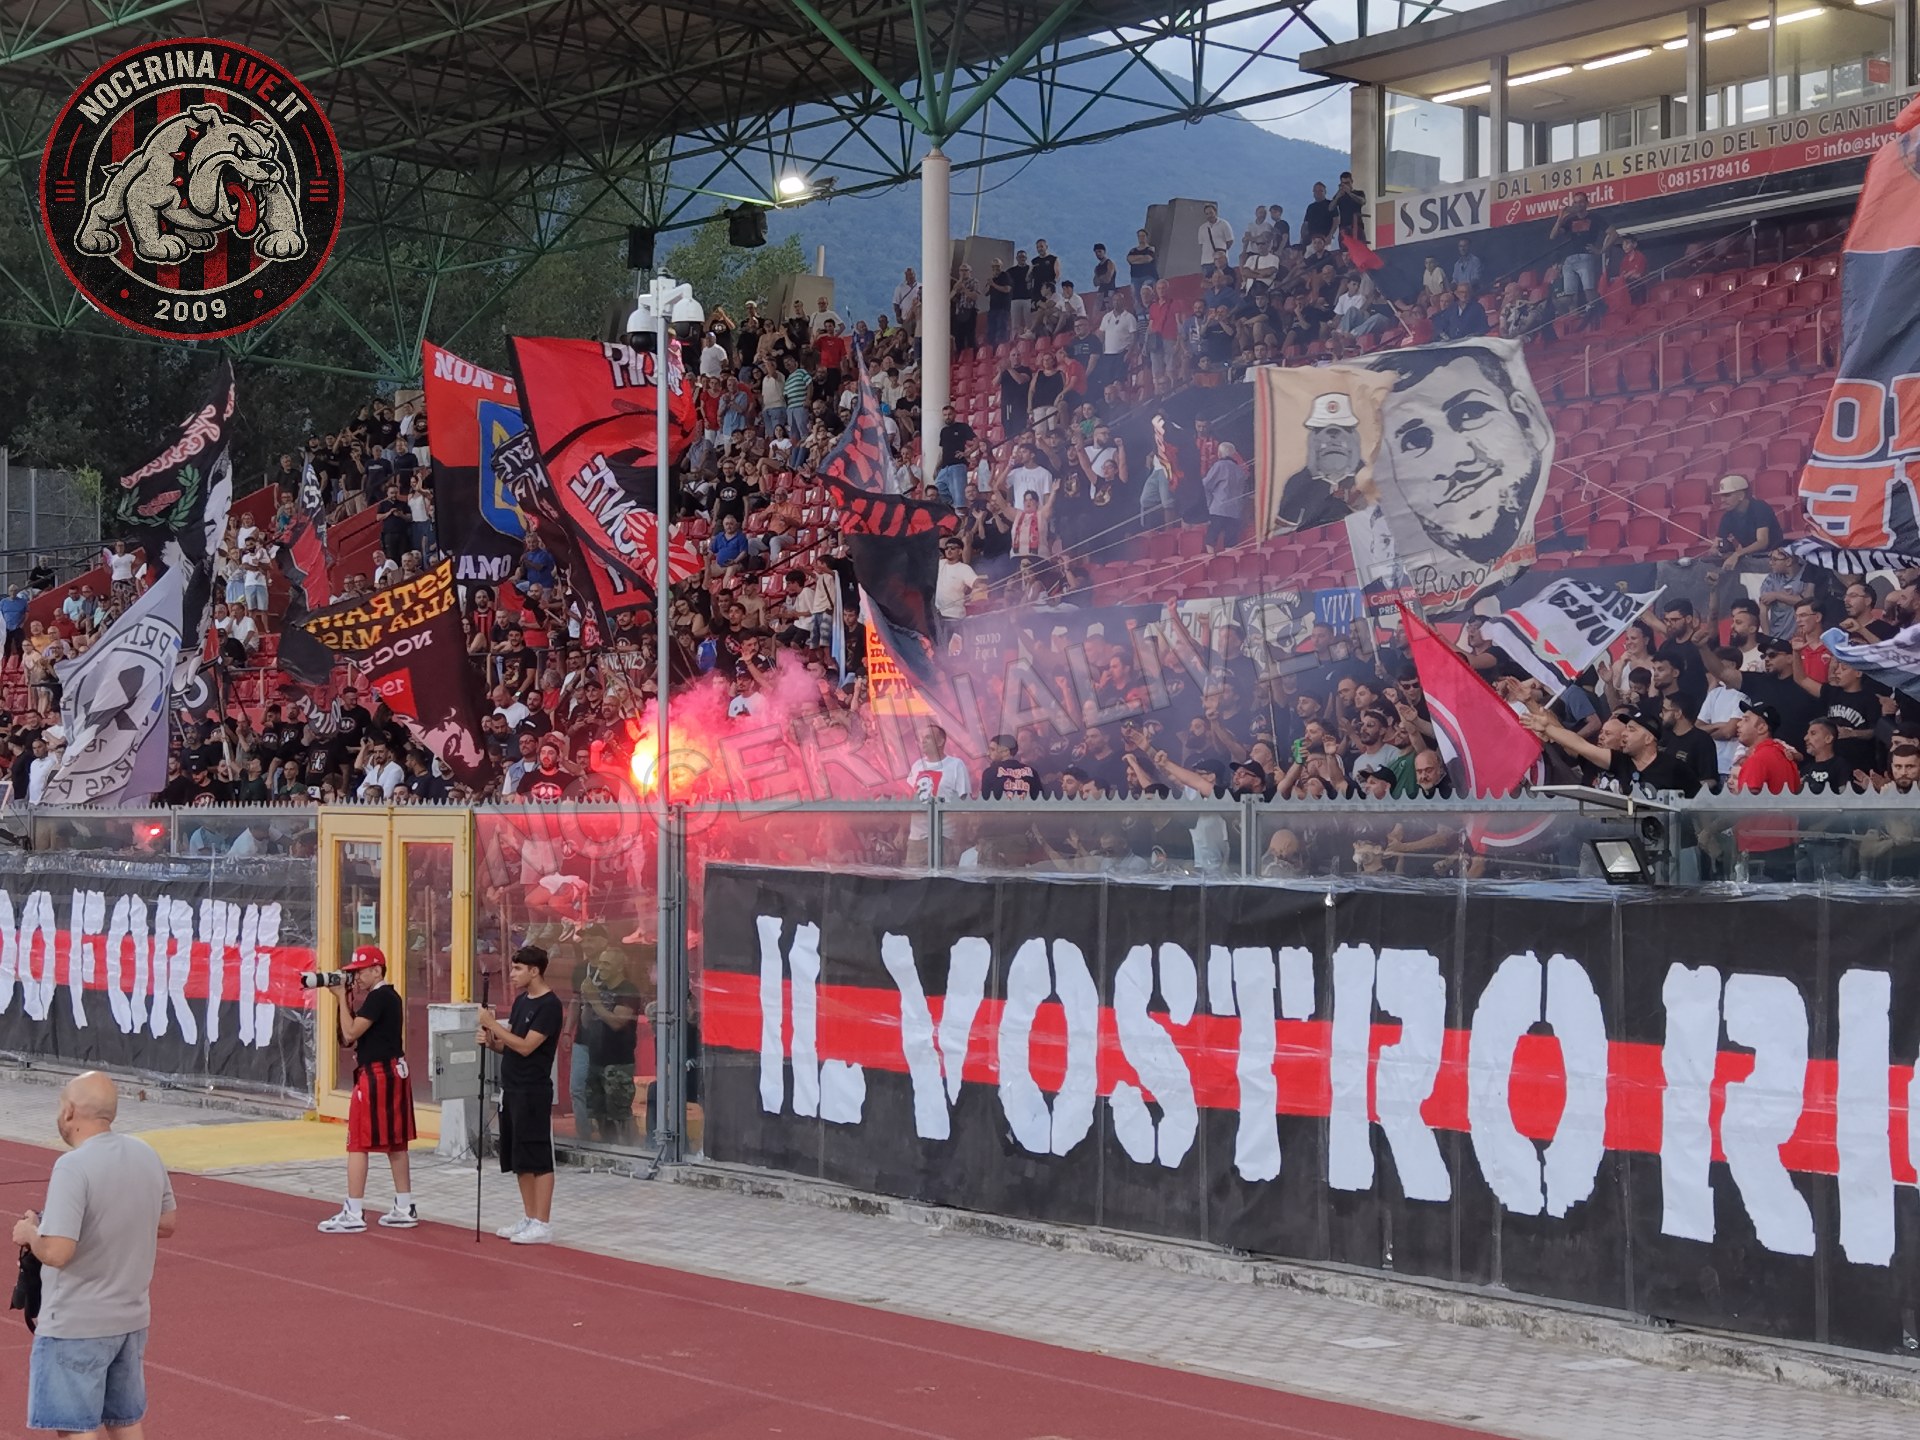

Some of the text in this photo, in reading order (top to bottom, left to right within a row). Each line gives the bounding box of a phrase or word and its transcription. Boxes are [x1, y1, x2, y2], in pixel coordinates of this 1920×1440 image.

[1497, 179, 1532, 200] DAL
[1540, 167, 1583, 190] 1981
[1592, 160, 1615, 181] AL
[1622, 139, 1714, 175] SERVIZIO
[1723, 131, 1760, 155] DEL
[1767, 119, 1810, 145] TUO
[1667, 158, 1750, 188] 0815178416
[1419, 188, 1487, 235] SKY
[434, 351, 495, 391] NON
[69, 887, 282, 1050] FORTE
[756, 914, 867, 1126] IL
[880, 929, 1608, 1219] VOSTRO
